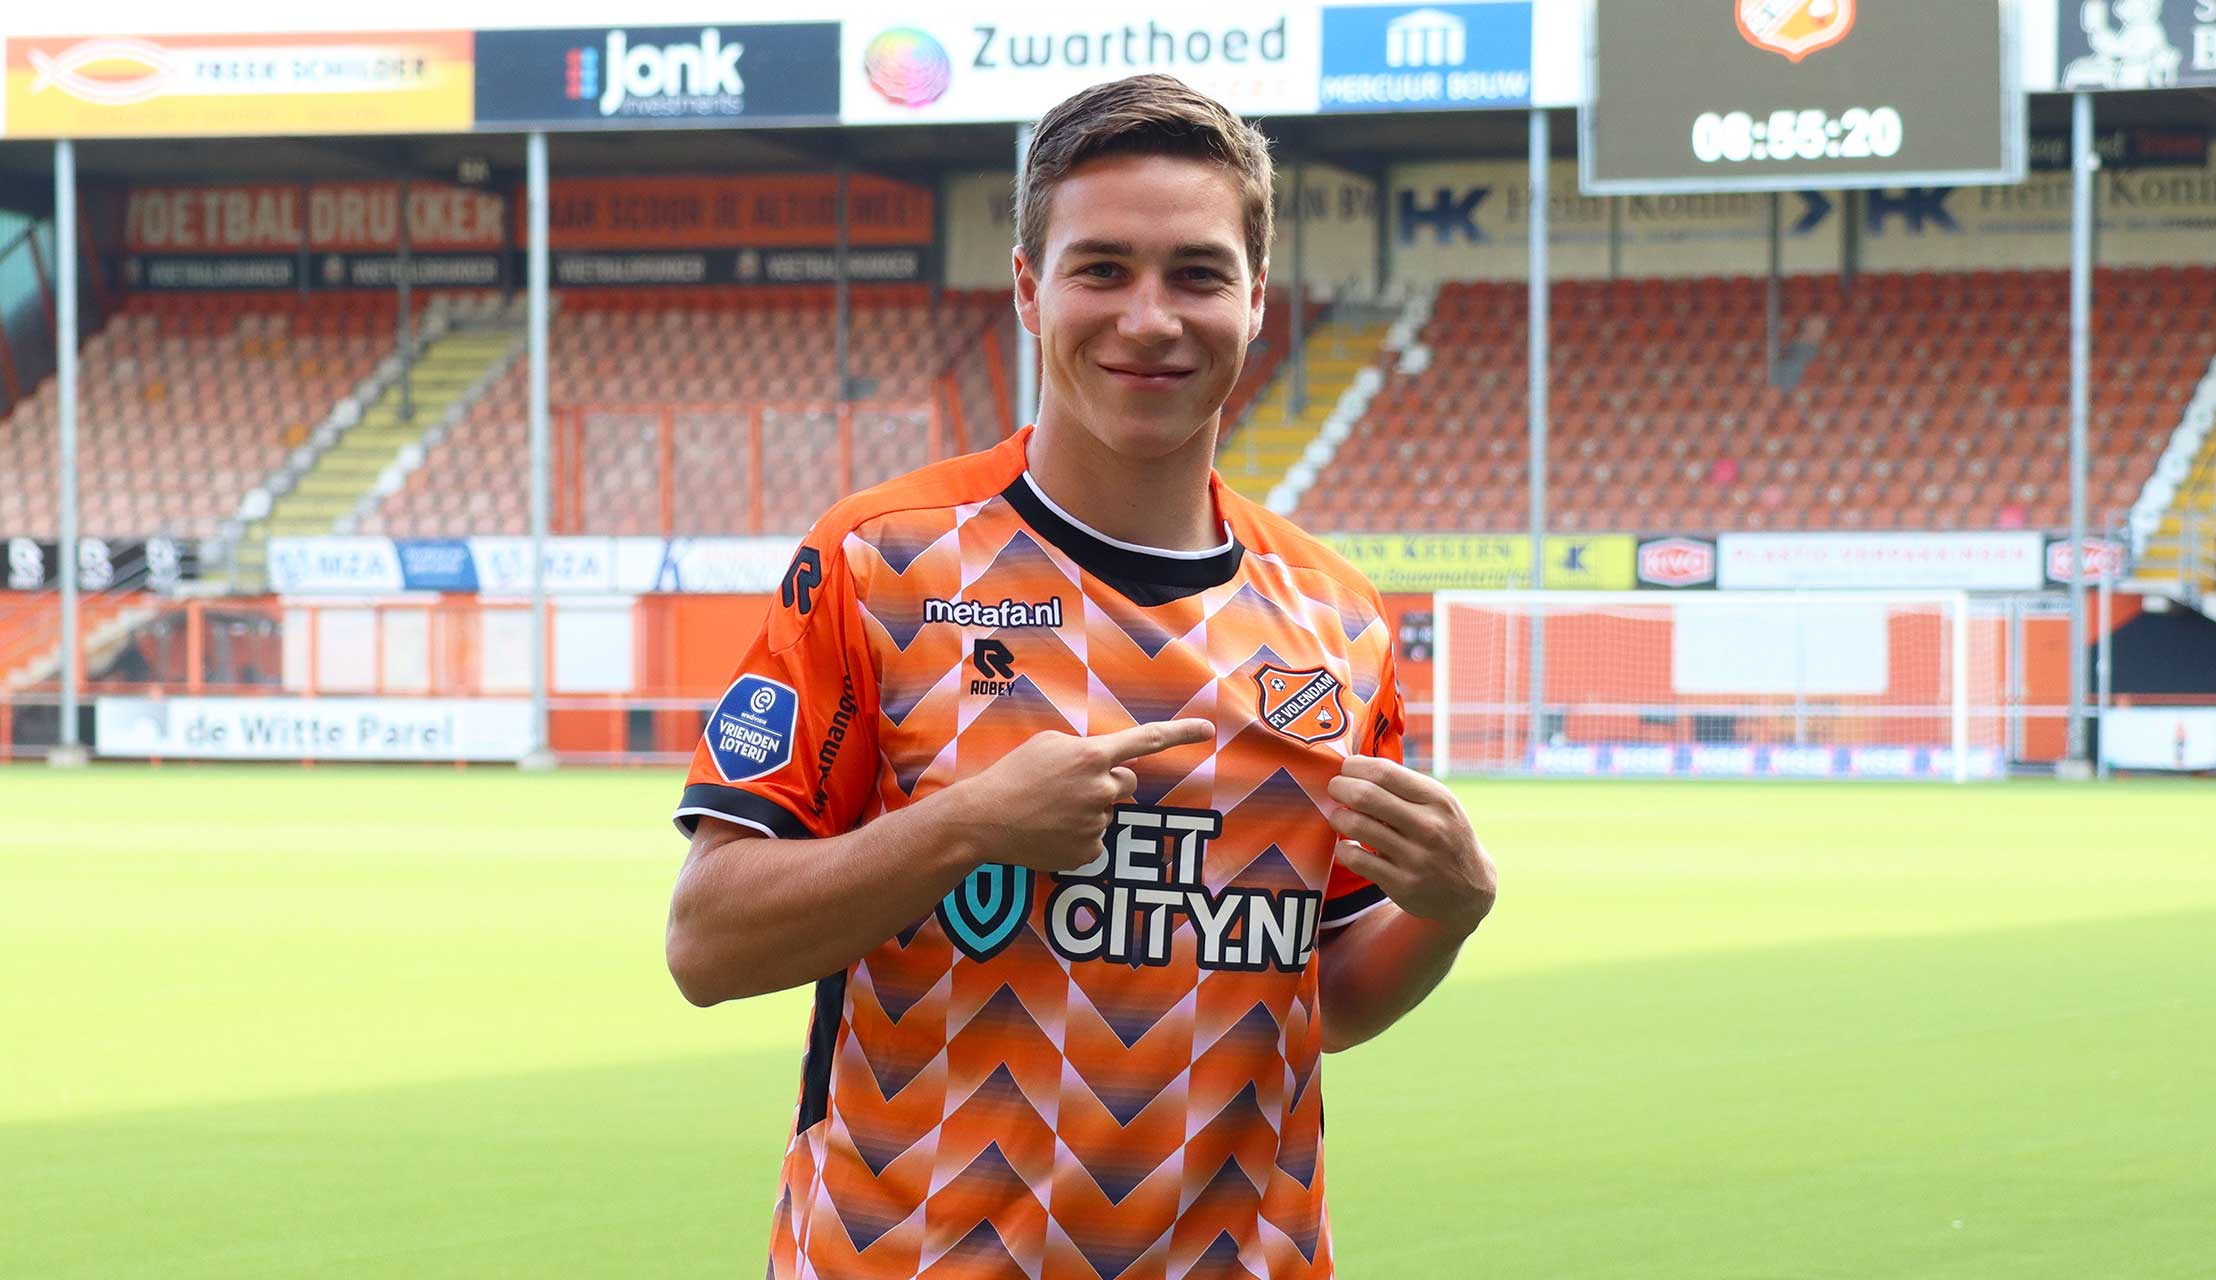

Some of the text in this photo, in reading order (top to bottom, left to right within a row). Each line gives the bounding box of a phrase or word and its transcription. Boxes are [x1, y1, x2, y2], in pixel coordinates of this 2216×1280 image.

[972, 17, 1287, 68] Zwarthoed
[599, 27, 745, 116] jonk
[1323, 73, 1442, 103] MERCUUR
[1446, 70, 1530, 99] BOUW
[924, 597, 1062, 627] metafa.nl
[970, 680, 1015, 696] ROBEY
[1269, 673, 1336, 728] FC VOLENDAM
[184, 714, 455, 745] de Witte Parel
[719, 720, 780, 753] VRIENDEN
[719, 737, 767, 763] LOTERIJ
